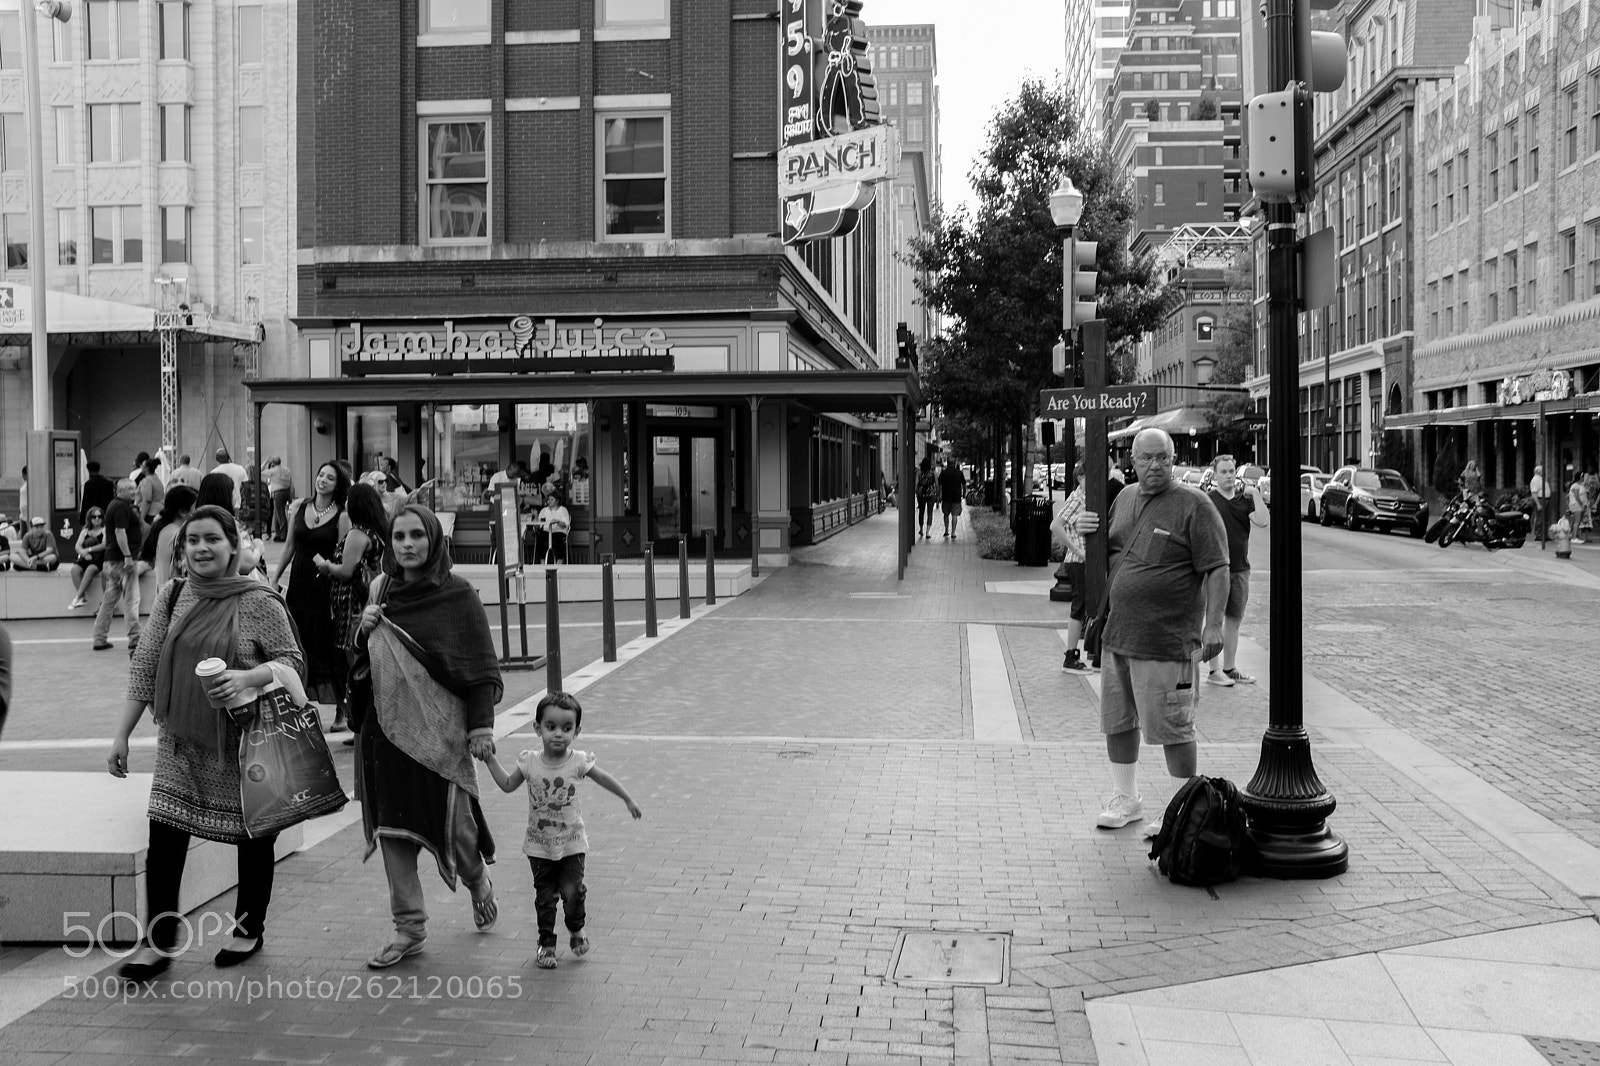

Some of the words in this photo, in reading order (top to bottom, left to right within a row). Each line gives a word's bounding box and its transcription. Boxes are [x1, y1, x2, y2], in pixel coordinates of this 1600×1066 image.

[786, 137, 876, 184] RANCH
[342, 320, 511, 354] Jamba
[535, 317, 674, 351] Juice
[674, 406, 688, 416] 103
[1047, 395, 1070, 411] Are
[1072, 394, 1096, 410] You
[1099, 391, 1147, 414] Ready?
[1249, 423, 1266, 431] LOFT
